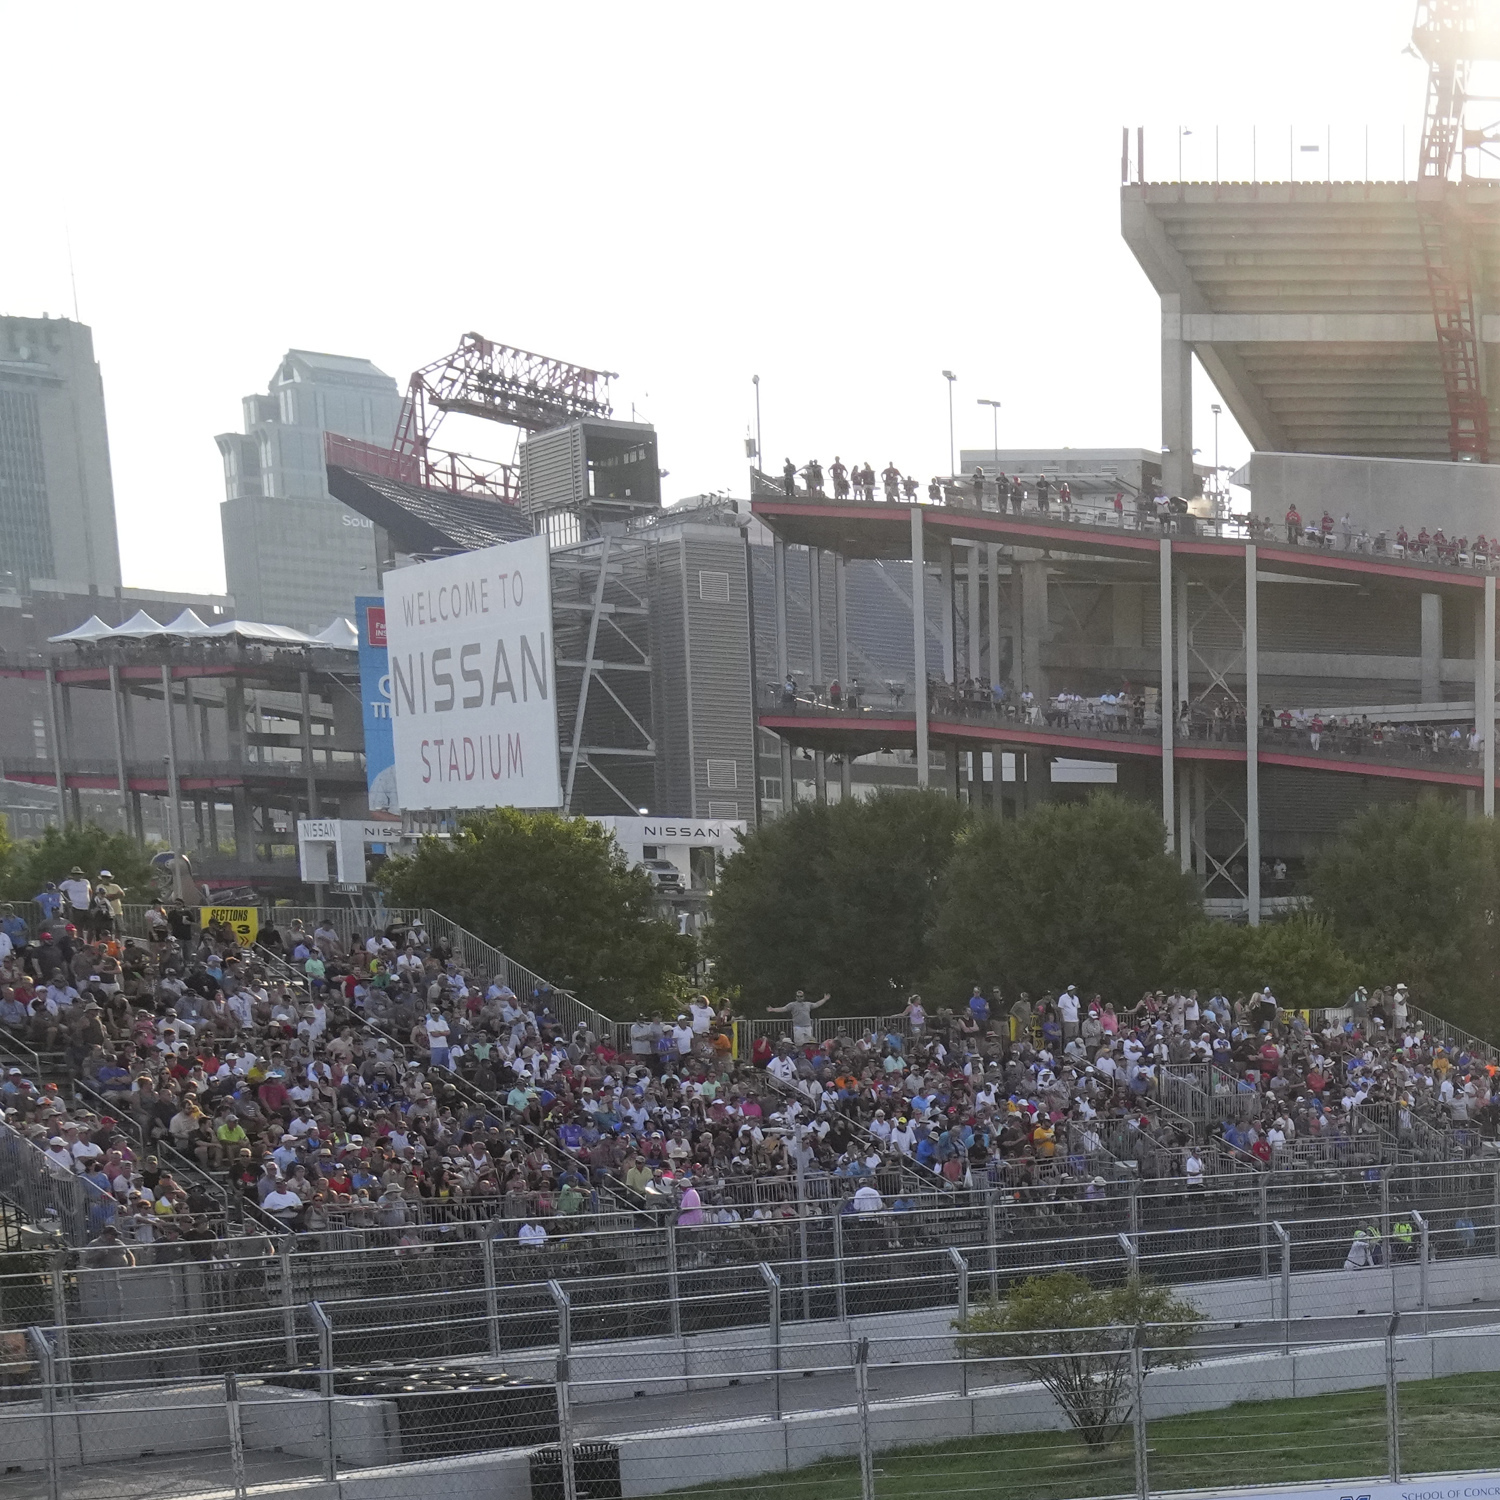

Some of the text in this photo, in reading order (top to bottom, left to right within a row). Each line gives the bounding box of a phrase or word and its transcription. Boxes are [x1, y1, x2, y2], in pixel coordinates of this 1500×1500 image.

[402, 570, 524, 628] WELCOME TO
[392, 631, 549, 717] NISSAN
[420, 731, 525, 784] STADIUM
[303, 821, 336, 838] NISSAN
[644, 824, 721, 838] NISSAN
[211, 908, 249, 922] SECTIONS
[1447, 1488, 1462, 1499] OF
